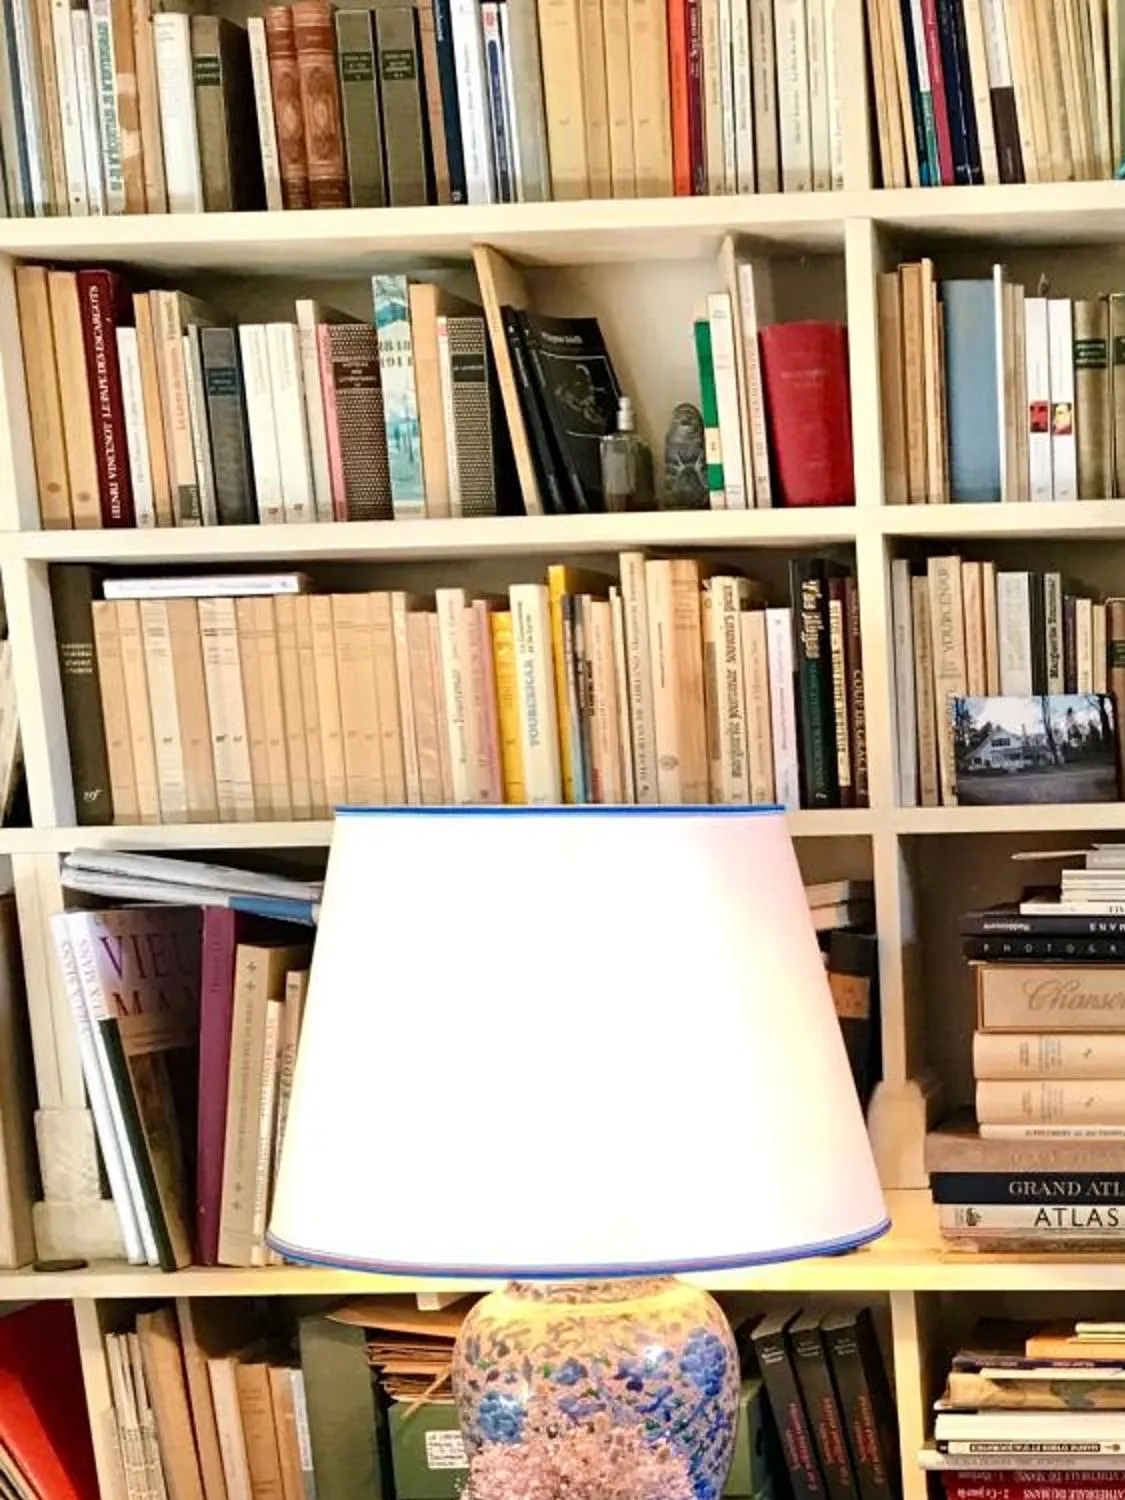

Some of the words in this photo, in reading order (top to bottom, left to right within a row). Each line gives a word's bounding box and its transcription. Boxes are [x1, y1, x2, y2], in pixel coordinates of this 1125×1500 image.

[102, 421, 117, 480] VINCENOT
[110, 481, 121, 519] HENRI
[1008, 1181, 1081, 1198] GRAND
[1034, 1207, 1119, 1228] ATLAS
[1023, 1488, 1051, 1500] MANS
